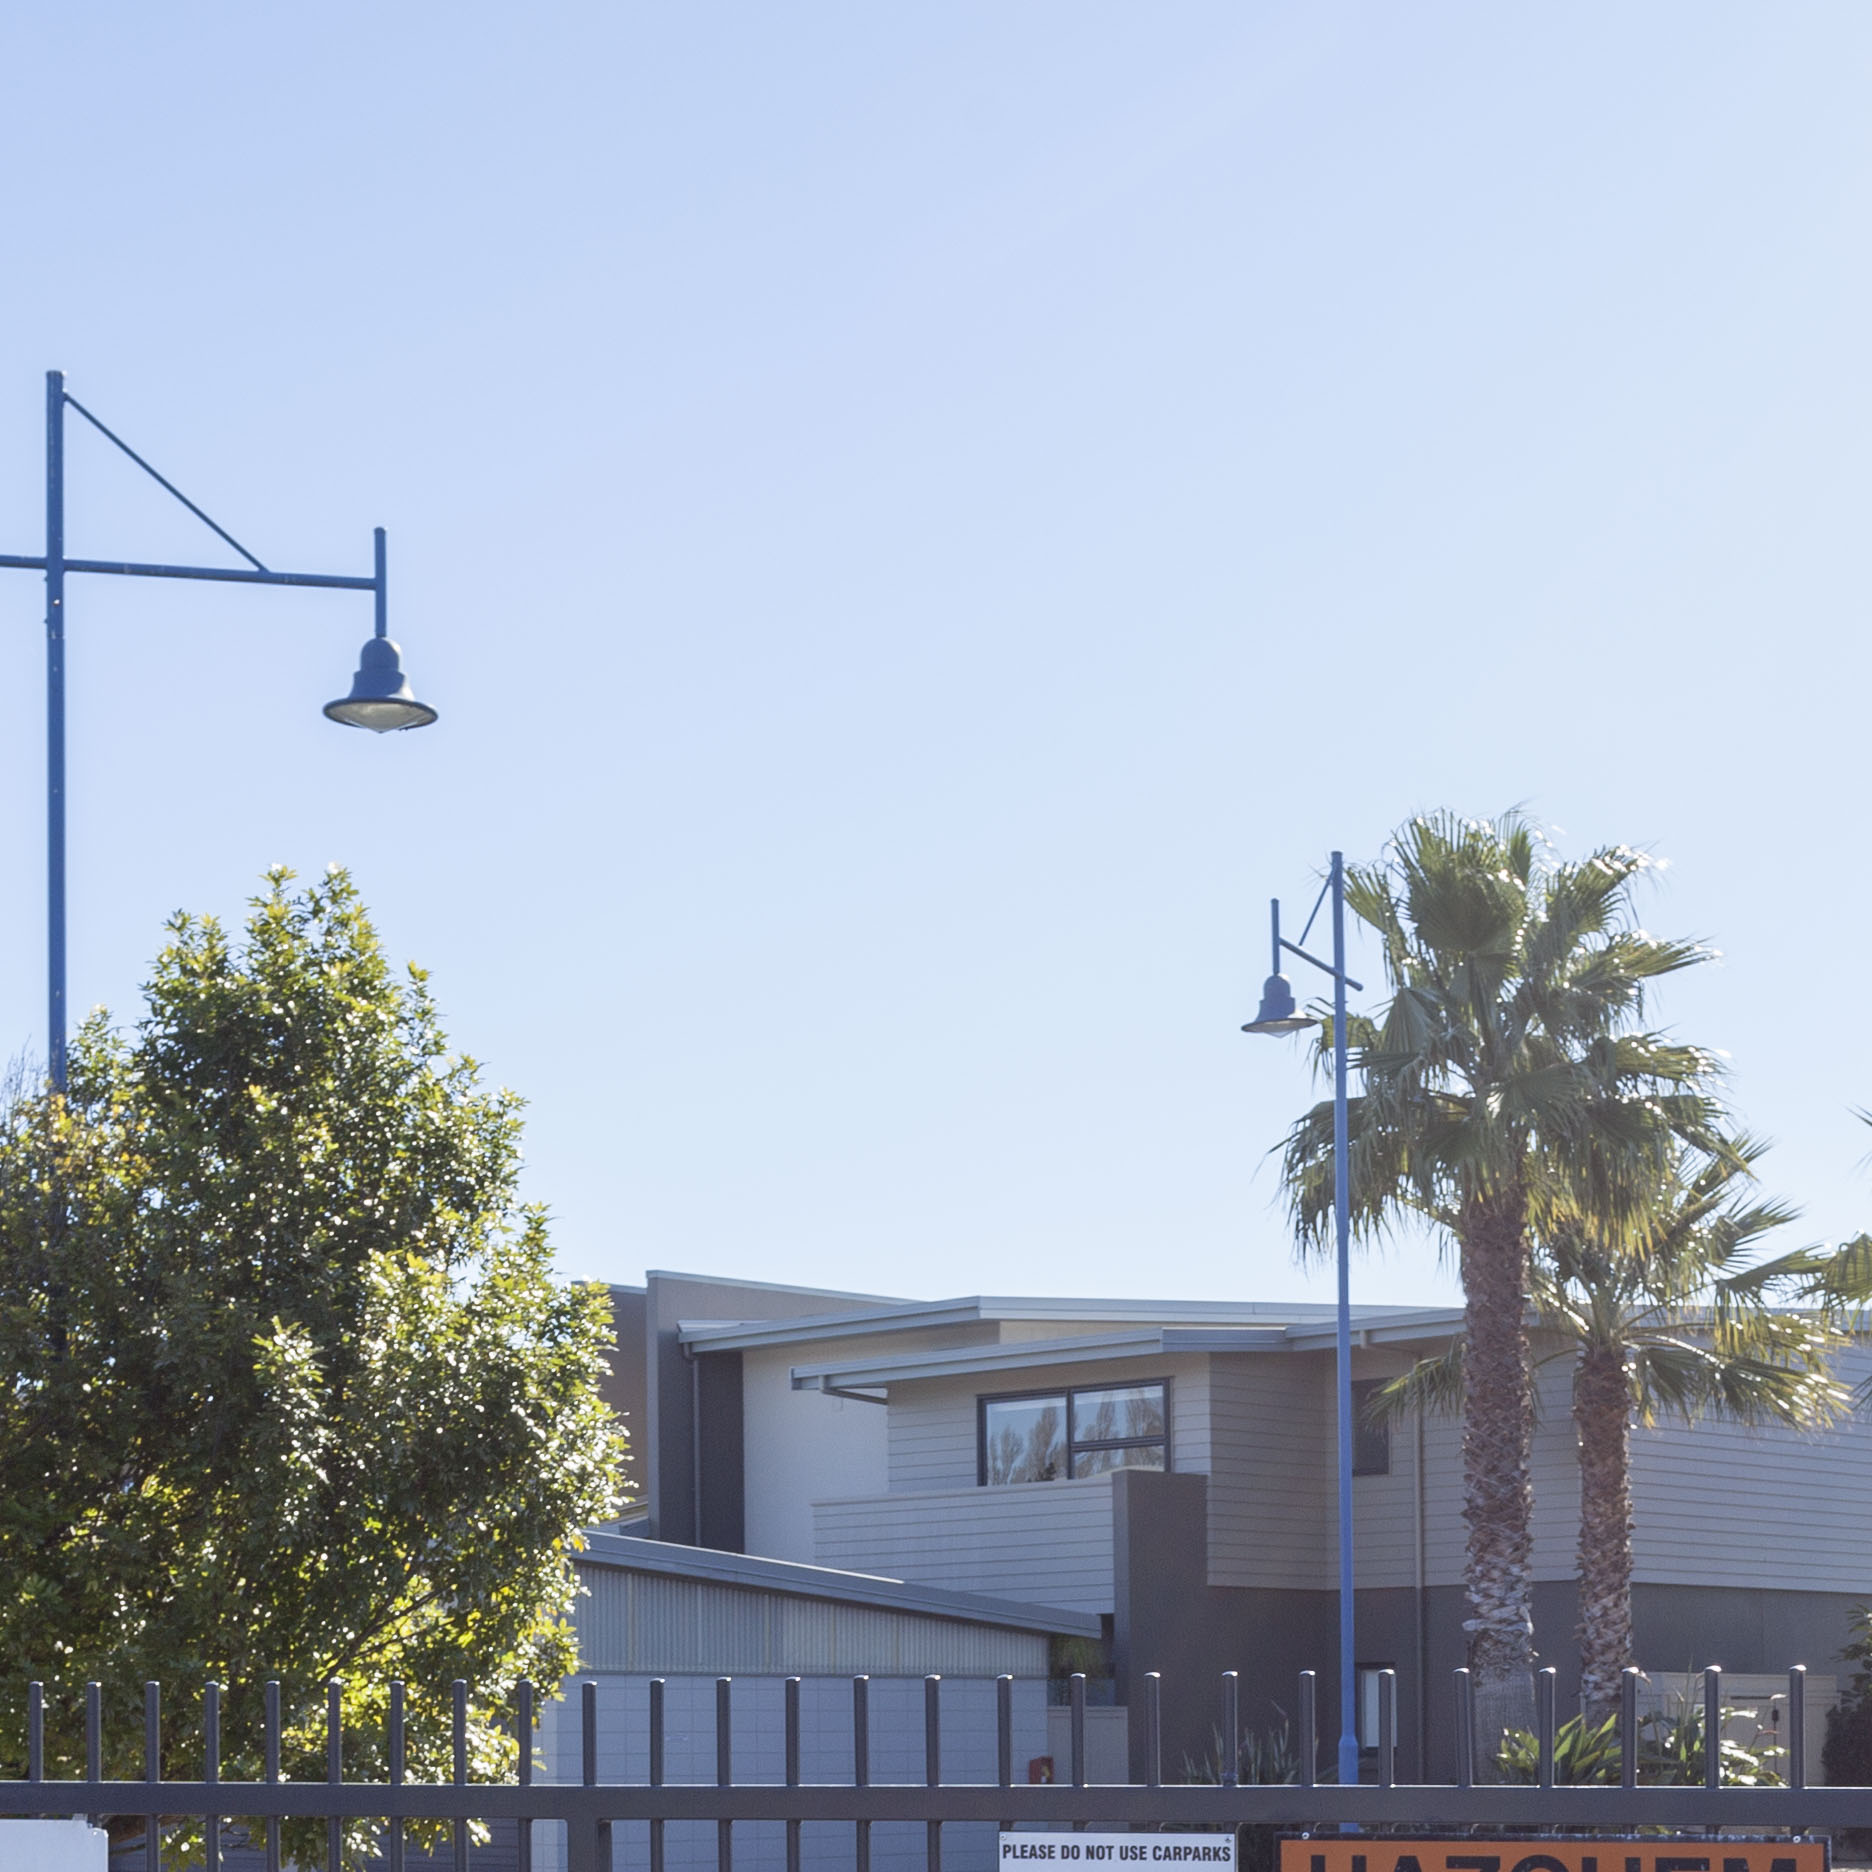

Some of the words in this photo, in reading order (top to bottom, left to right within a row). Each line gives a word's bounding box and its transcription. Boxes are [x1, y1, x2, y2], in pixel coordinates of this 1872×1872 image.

[1003, 1844, 1055, 1859] PLEASE
[1061, 1845, 1080, 1860] DO
[1086, 1845, 1114, 1860] NOT
[1120, 1846, 1147, 1860] USE
[1153, 1846, 1231, 1862] CARPARKS
